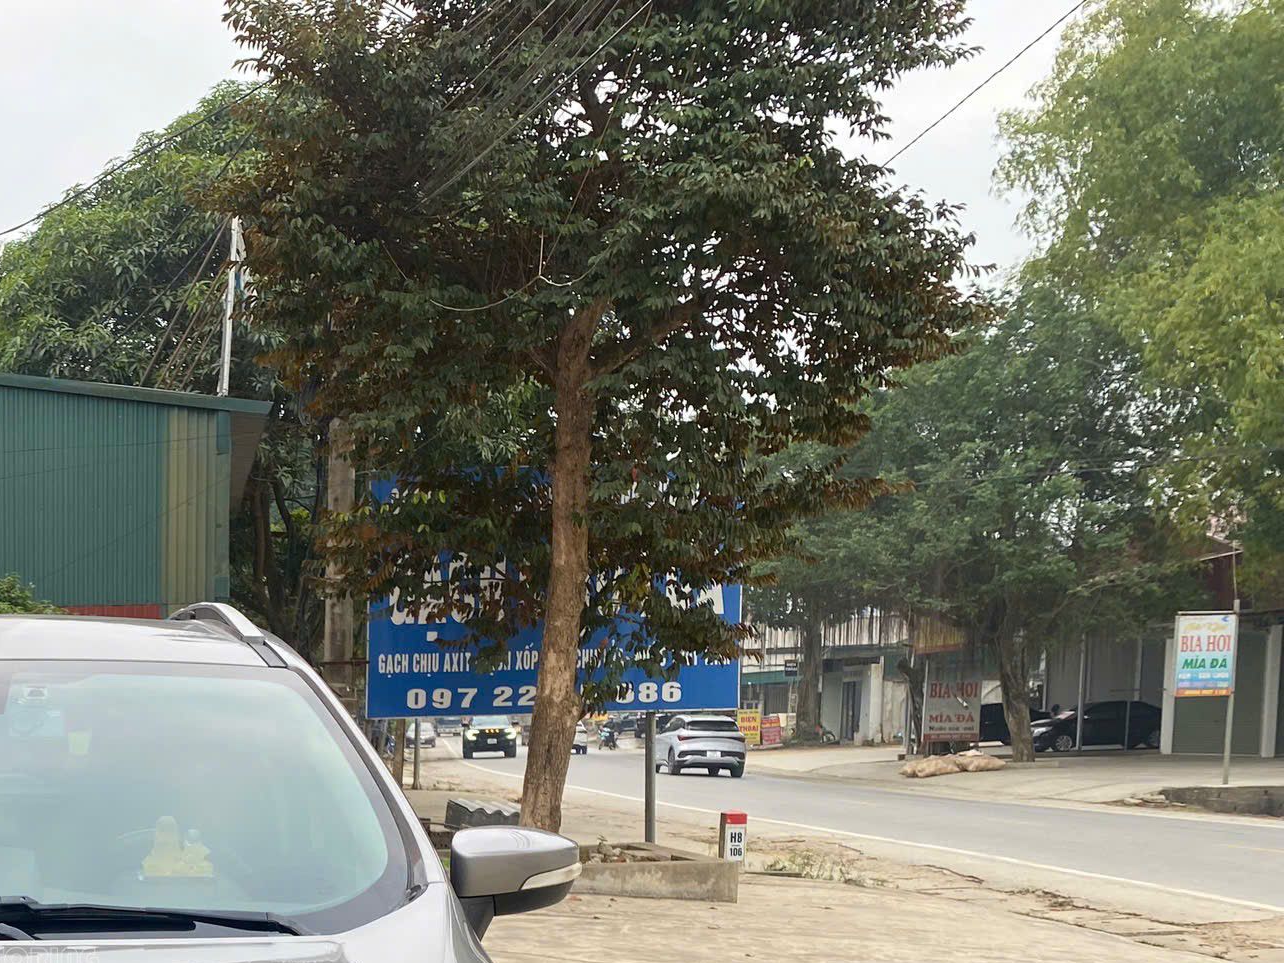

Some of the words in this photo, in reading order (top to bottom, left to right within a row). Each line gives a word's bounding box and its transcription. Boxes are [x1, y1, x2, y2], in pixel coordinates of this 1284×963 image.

[1180, 635, 1202, 652] BIA
[378, 653, 409, 678] GẠCH
[413, 652, 439, 677] CHỊU
[516, 642, 538, 671] XỐP
[406, 687, 478, 709] 097
[730, 832, 742, 843] H8
[730, 848, 742, 856] 106
